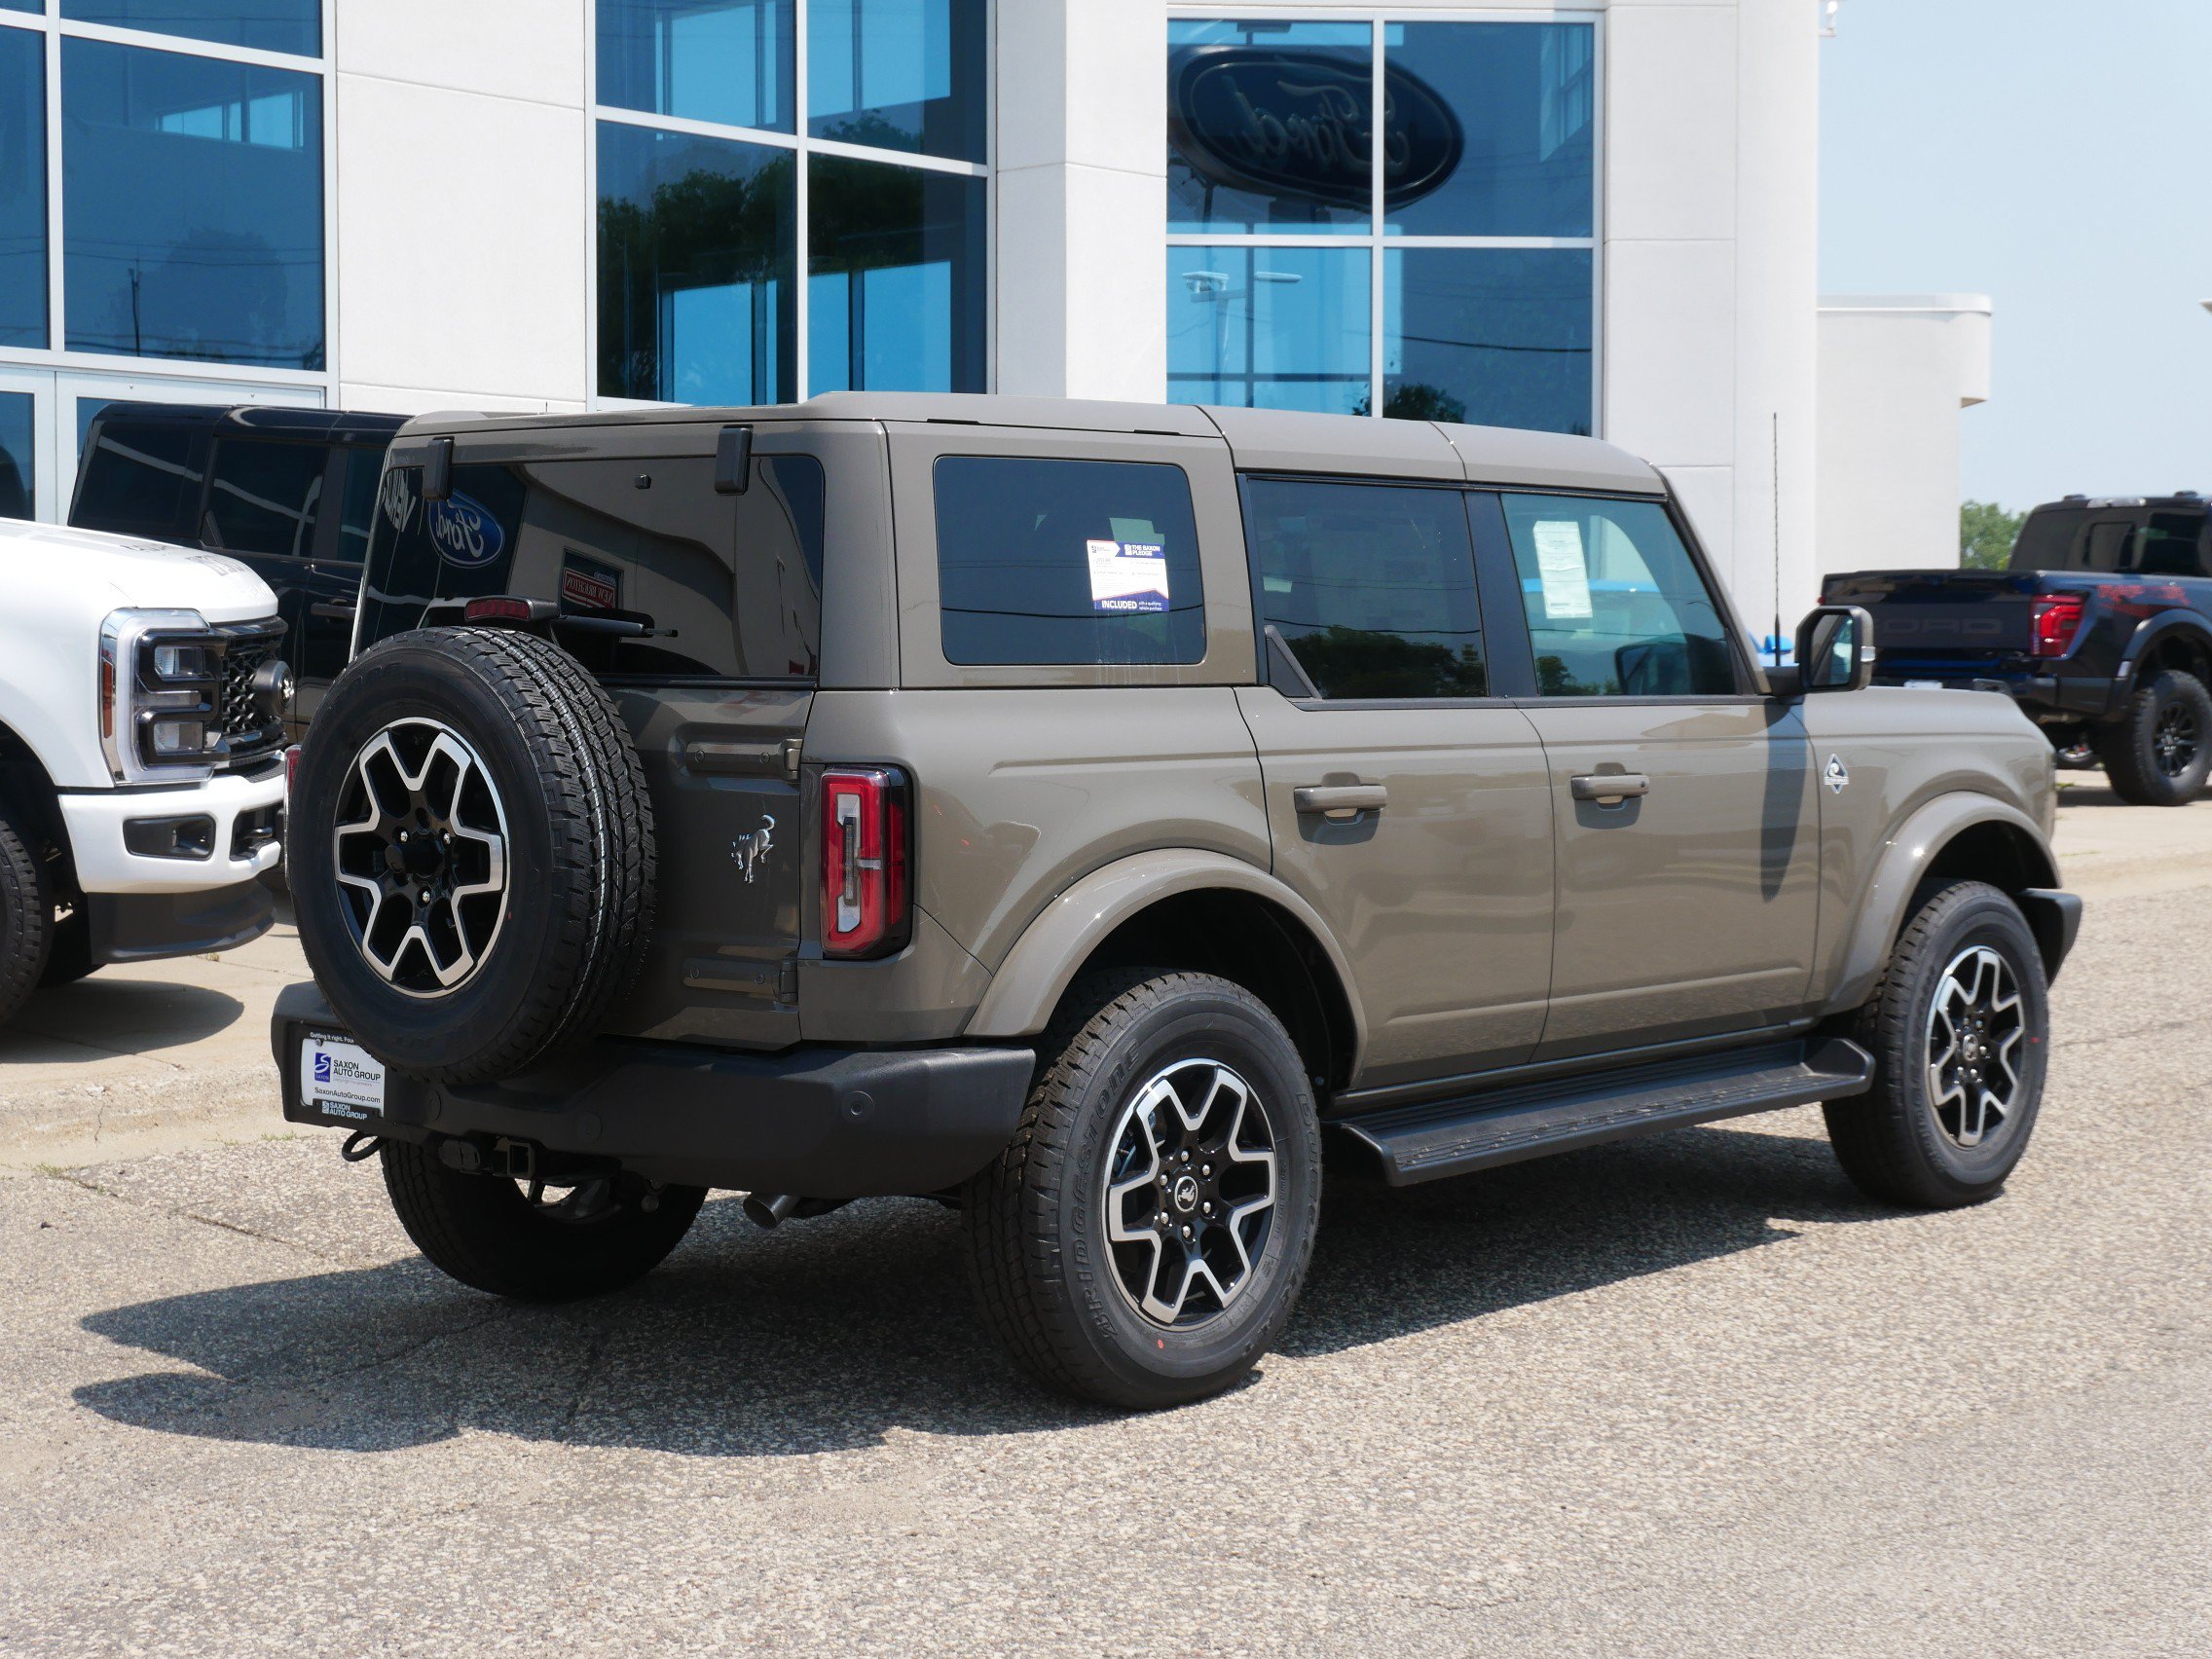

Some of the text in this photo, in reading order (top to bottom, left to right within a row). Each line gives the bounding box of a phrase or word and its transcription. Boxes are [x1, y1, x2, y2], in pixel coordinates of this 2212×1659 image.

[1101, 600, 1137, 609] INCLUDED
[1875, 617, 2002, 635] ORD
[333, 1059, 359, 1071] SAXON
[333, 1068, 352, 1078] AUTO
[353, 1071, 381, 1082] GROUP
[314, 1087, 381, 1104] SaxonAutoGroup.com
[329, 1101, 351, 1112] SAXON
[329, 1107, 368, 1121] AUTO GROUP
[1070, 1039, 1142, 1340] BRIDGESTONE
